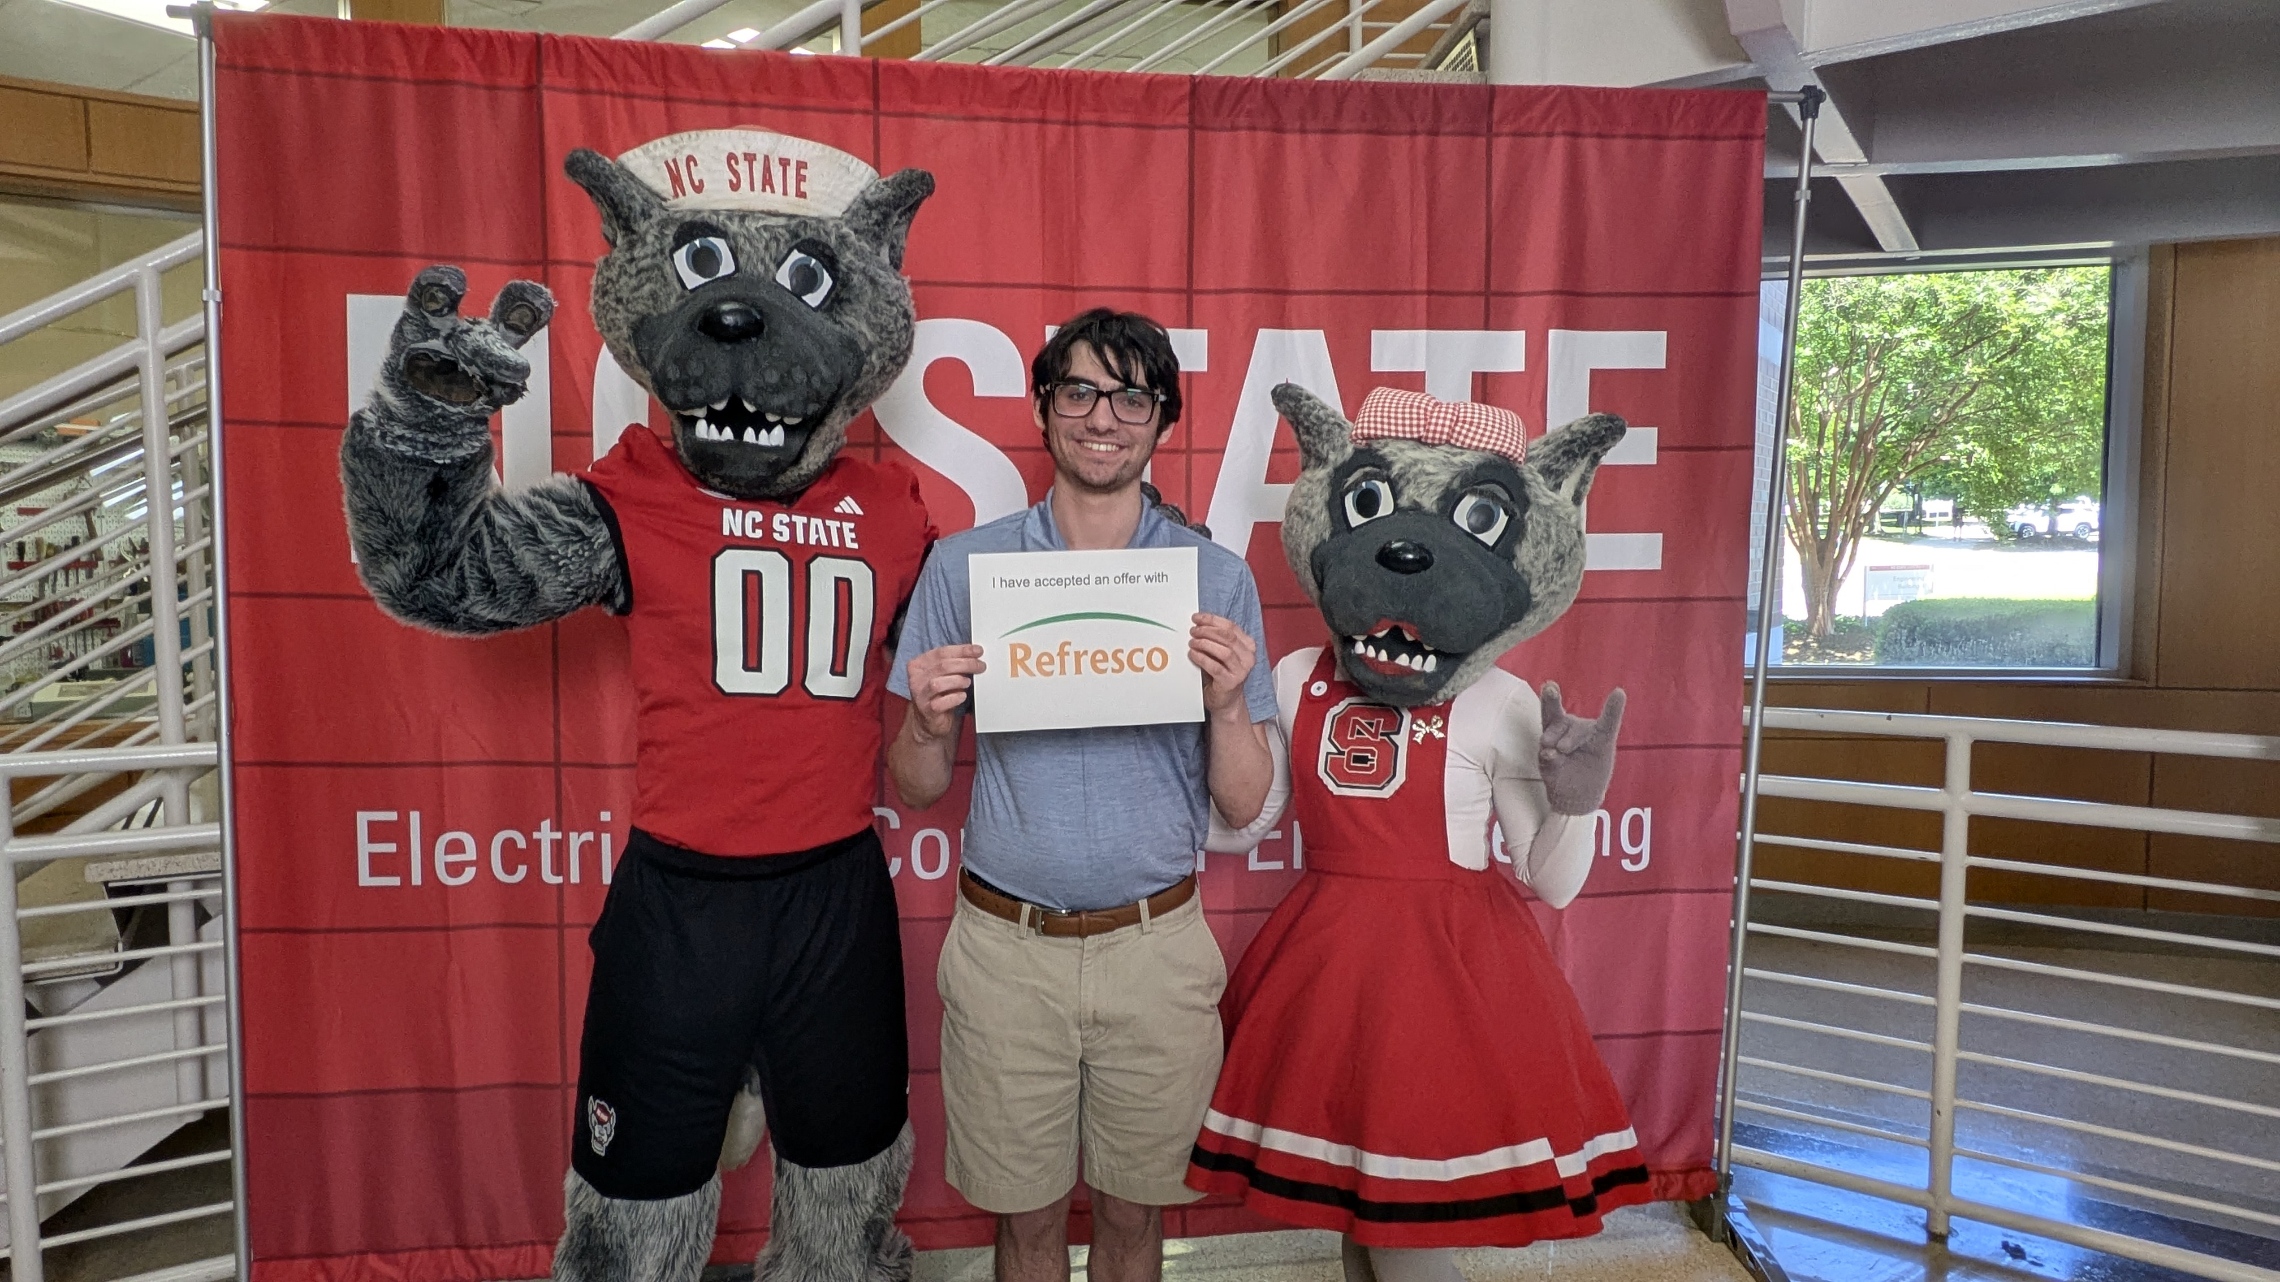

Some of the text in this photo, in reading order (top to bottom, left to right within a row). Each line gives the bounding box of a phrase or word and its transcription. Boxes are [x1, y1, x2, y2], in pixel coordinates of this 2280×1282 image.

[664, 152, 808, 199] NC STATE
[722, 508, 859, 549] NC STATE
[992, 571, 1169, 589] I have accepted an offer with
[710, 545, 877, 703] 00
[1009, 641, 1169, 678] Refresco
[356, 810, 614, 887] Electri
